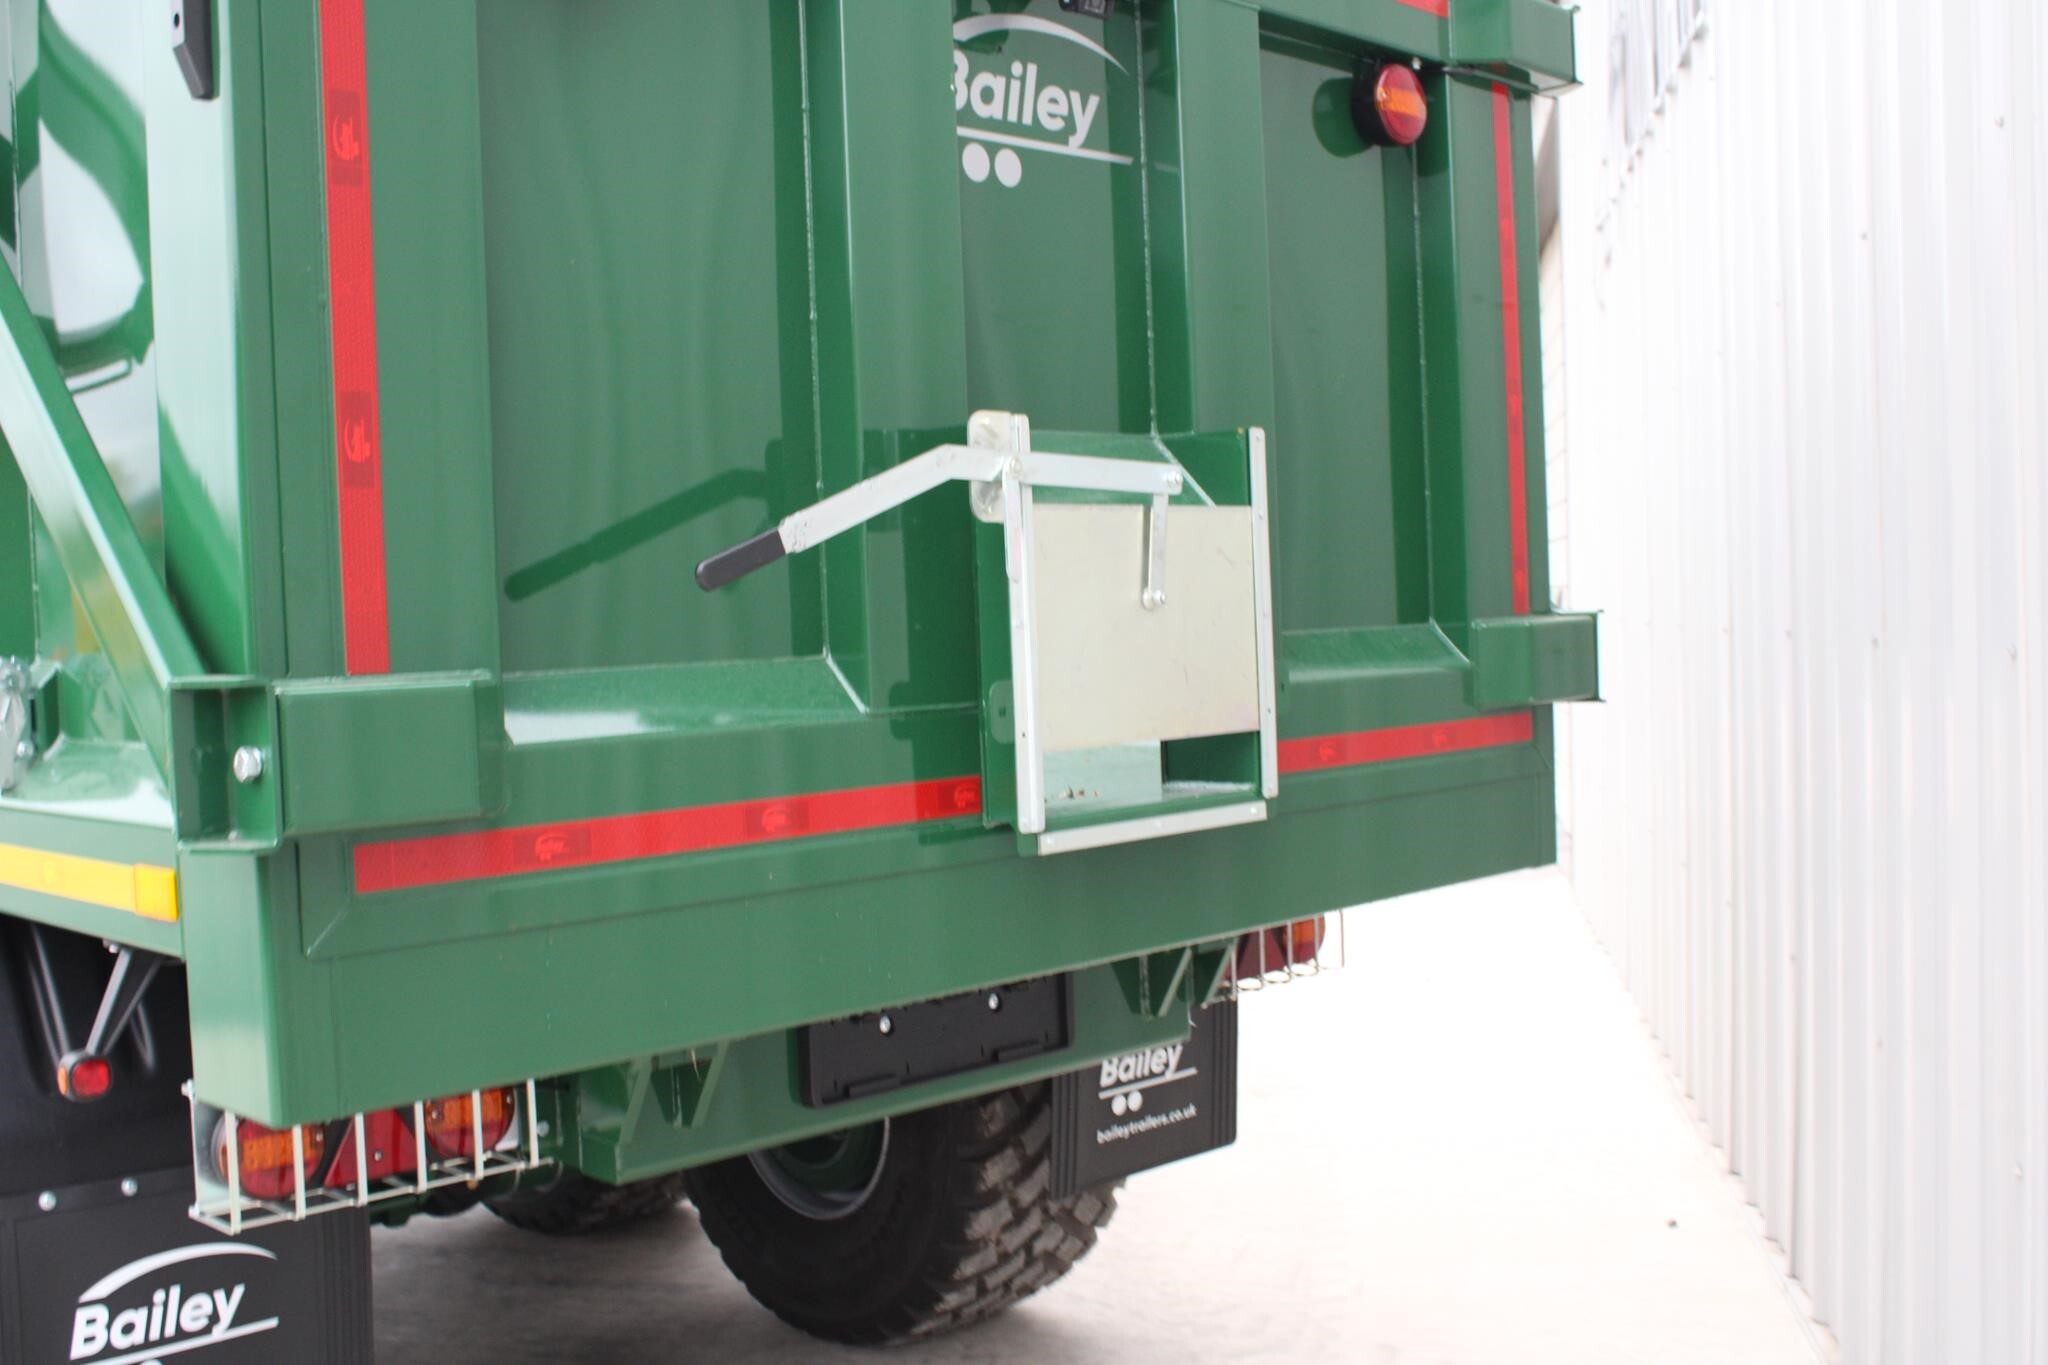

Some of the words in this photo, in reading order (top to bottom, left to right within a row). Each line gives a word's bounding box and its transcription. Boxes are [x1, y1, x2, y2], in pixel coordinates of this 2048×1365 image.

[1100, 1042, 1184, 1088] Bailey
[1096, 1102, 1198, 1145] baileytrailers.co.uk
[69, 1283, 246, 1361] Bailey
